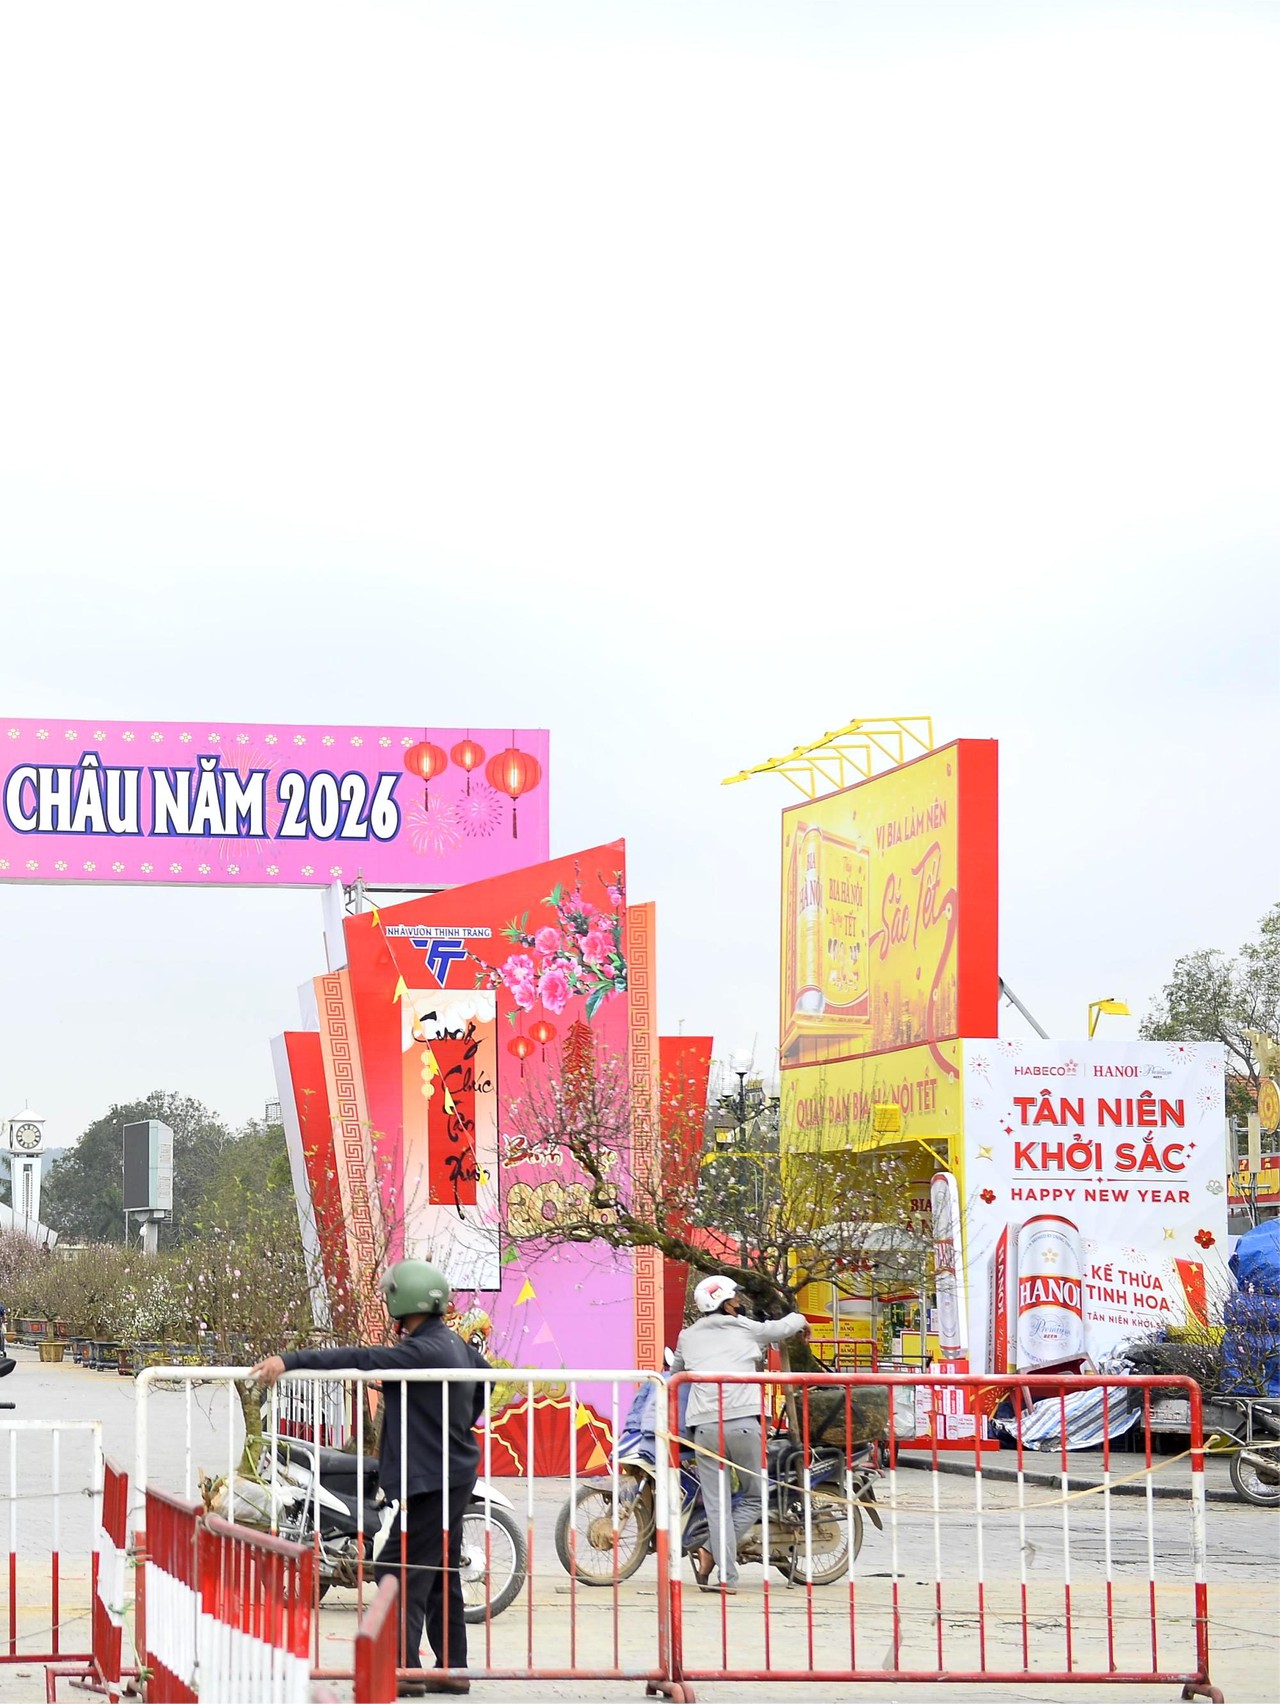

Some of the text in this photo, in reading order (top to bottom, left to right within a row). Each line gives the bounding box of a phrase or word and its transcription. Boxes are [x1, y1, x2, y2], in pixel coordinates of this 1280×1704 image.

[3, 753, 144, 838] CHÂU
[148, 754, 271, 838] NĂM
[274, 769, 403, 843] 2026
[887, 820, 902, 848] BIA
[905, 806, 925, 841] LÀM
[927, 797, 947, 833] NÊN
[387, 924, 407, 937] NHÀ
[435, 928, 460, 939] THỊNH
[463, 928, 491, 938] TRANG
[412, 1010, 488, 1060] Cung
[441, 1065, 495, 1095] Chúc
[1014, 1066, 1066, 1077] HABECO
[1093, 1065, 1139, 1078] HANOI
[916, 1066, 937, 1111] TẾT
[1013, 1088, 1186, 1128] TÂN NIÊN
[1014, 1130, 1187, 1173] KHỞI SẮC
[1011, 1188, 1191, 1203] HAPPY NEW YEAR
[1092, 1263, 1164, 1292] KẾ THỪA
[1020, 1278, 1081, 1310] HANOI
[1086, 1284, 1171, 1312] TINH HOA
[1087, 1311, 1105, 1322] TÂN
[1108, 1314, 1129, 1326] NIÊN
